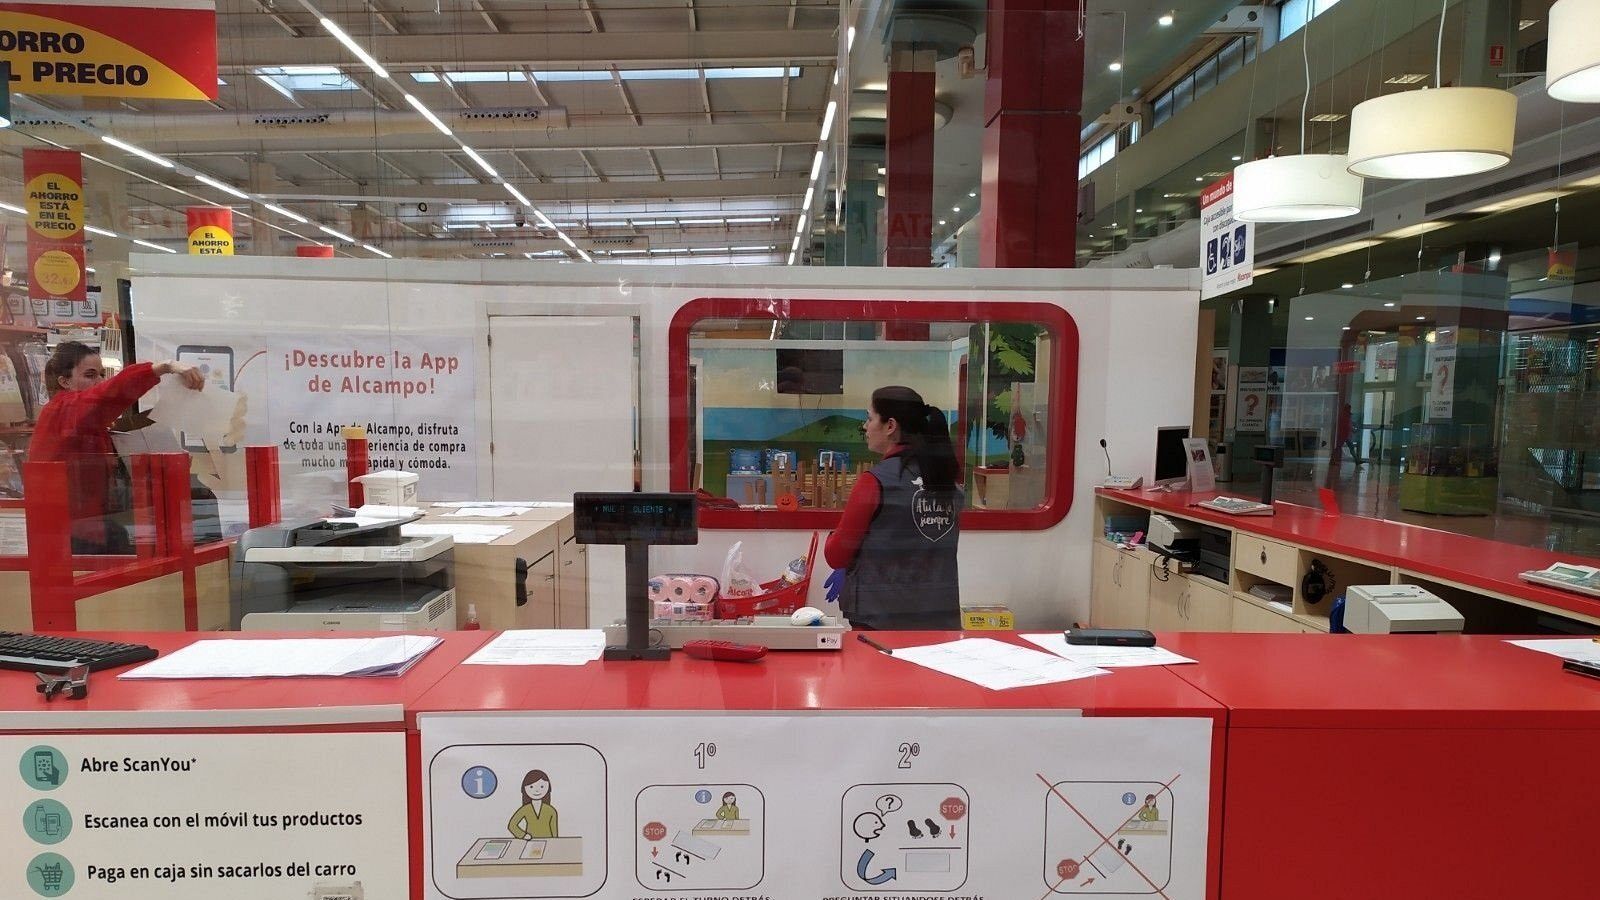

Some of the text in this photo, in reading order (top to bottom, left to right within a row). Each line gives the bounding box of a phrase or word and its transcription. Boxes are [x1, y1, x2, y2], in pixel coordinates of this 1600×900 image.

[33, 62, 148, 85] PRECIO
[46, 180, 61, 191] EL
[29, 190, 80, 202] AHORRO
[39, 200, 71, 212] ESTÁ
[38, 210, 71, 221] EN EL
[34, 221, 77, 232] PRECIO
[204, 231, 215, 240] EL
[191, 238, 230, 248] AHORRO
[199, 246, 223, 255] ESTÁ
[285, 349, 458, 374] ¡Descubre la App
[309, 375, 434, 395] de Alcampo!
[290, 422, 308, 433] Con
[314, 422, 322, 433] la
[367, 423, 413, 438] Alcampo,
[418, 423, 458, 435] disfruta
[284, 437, 297, 451] de
[299, 438, 324, 451] toda
[327, 441, 346, 451] una
[413, 440, 424, 451] de
[429, 443, 465, 454] compra
[302, 456, 336, 468] mucho
[368, 457, 394, 470] ápida
[399, 460, 403, 471] y
[408, 457, 450, 468] cómoda.
[920, 514, 951, 530] siempre
[827, 637, 838, 646] Pay
[81, 758, 118, 771] Abre
[942, 804, 964, 814] STOP
[85, 812, 362, 830] Escanea con el móvil tus productos
[644, 826, 665, 837] STOP
[88, 862, 355, 883] Paga en caja sin sacarlos del carro
